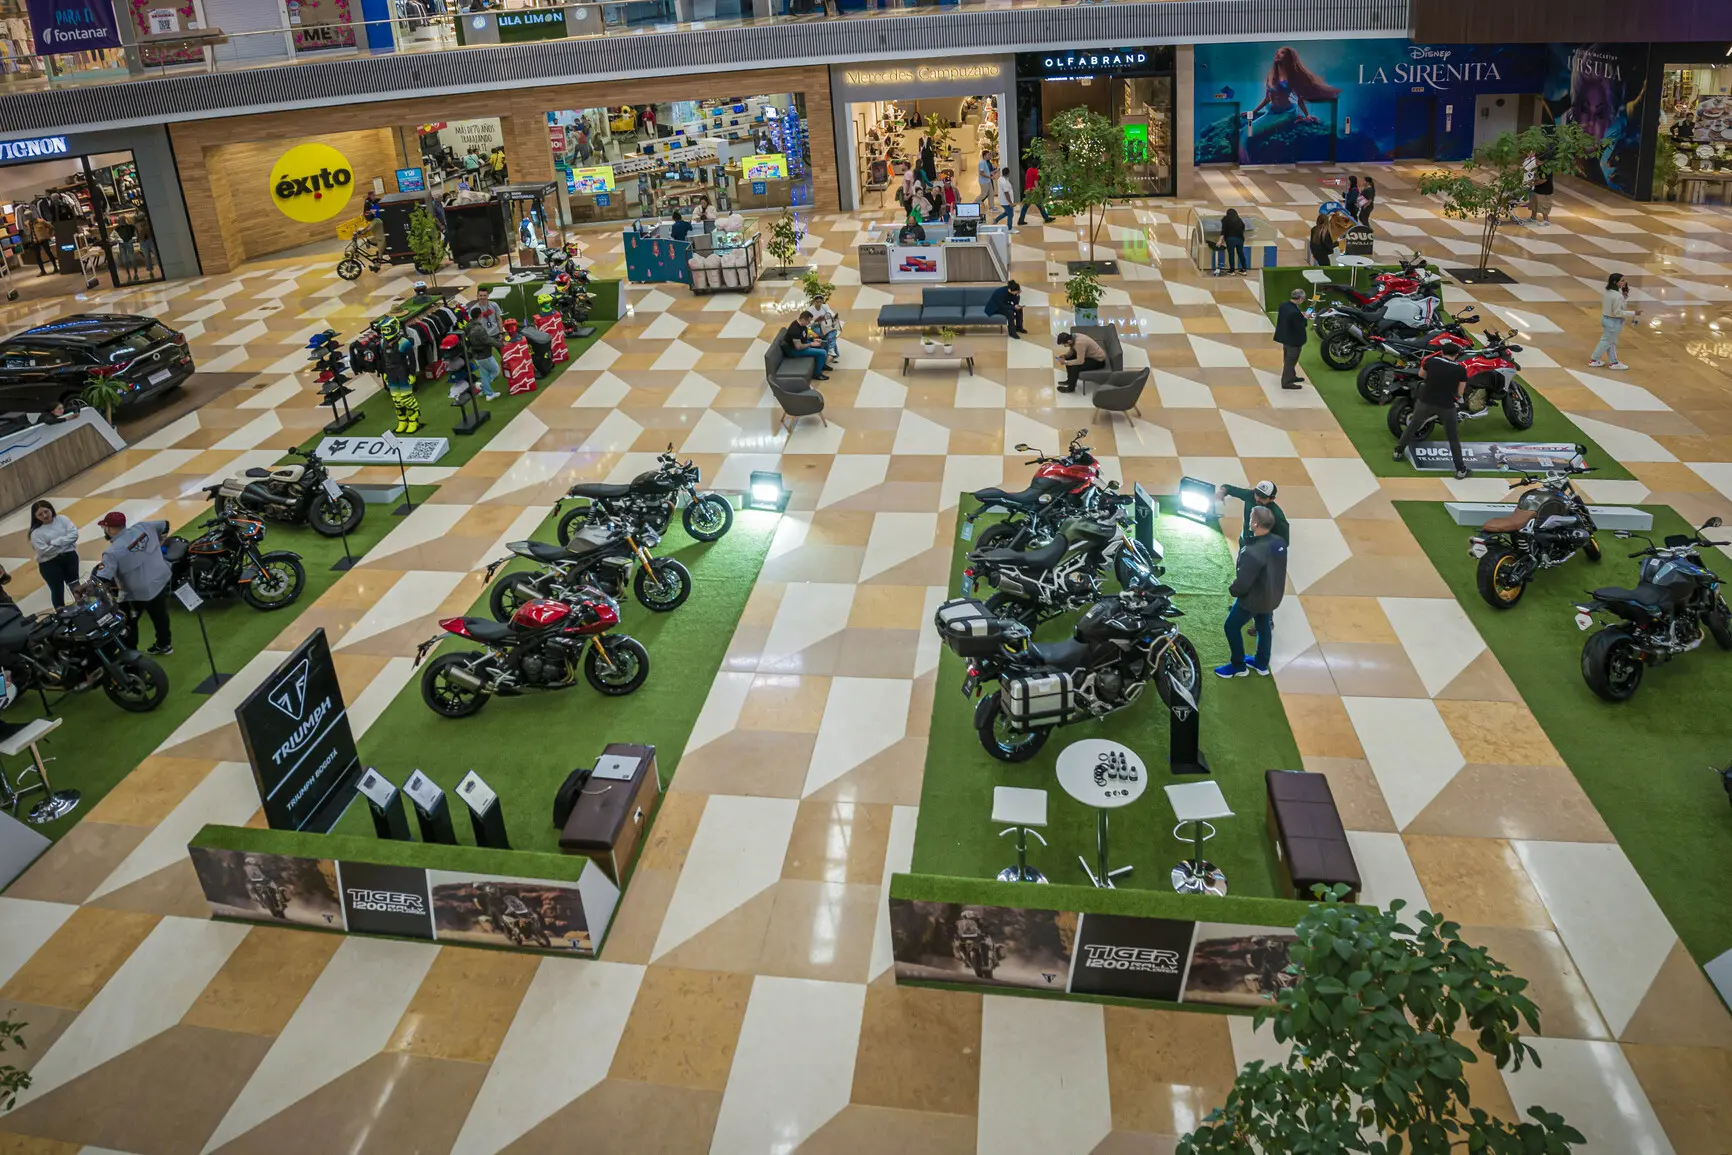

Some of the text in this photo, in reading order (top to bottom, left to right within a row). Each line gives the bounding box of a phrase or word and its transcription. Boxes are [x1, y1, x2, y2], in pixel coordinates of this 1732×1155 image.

[55, 10, 80, 25] PARA
[499, 17, 522, 26] LILA
[54, 28, 107, 42] fontanar
[1045, 54, 1146, 67] OLFABRAND
[847, 66, 1000, 84] Mercedes Campuzano
[1358, 62, 1501, 90] LA SIRENITA
[275, 167, 351, 199] éxito
[272, 696, 332, 765] TRIUMPH
[286, 775, 316, 811] TRIUMPH
[347, 888, 424, 908] TIGER
[352, 901, 387, 912] 1200
[1084, 944, 1180, 966] TIGER
[1086, 958, 1130, 970] 1200
